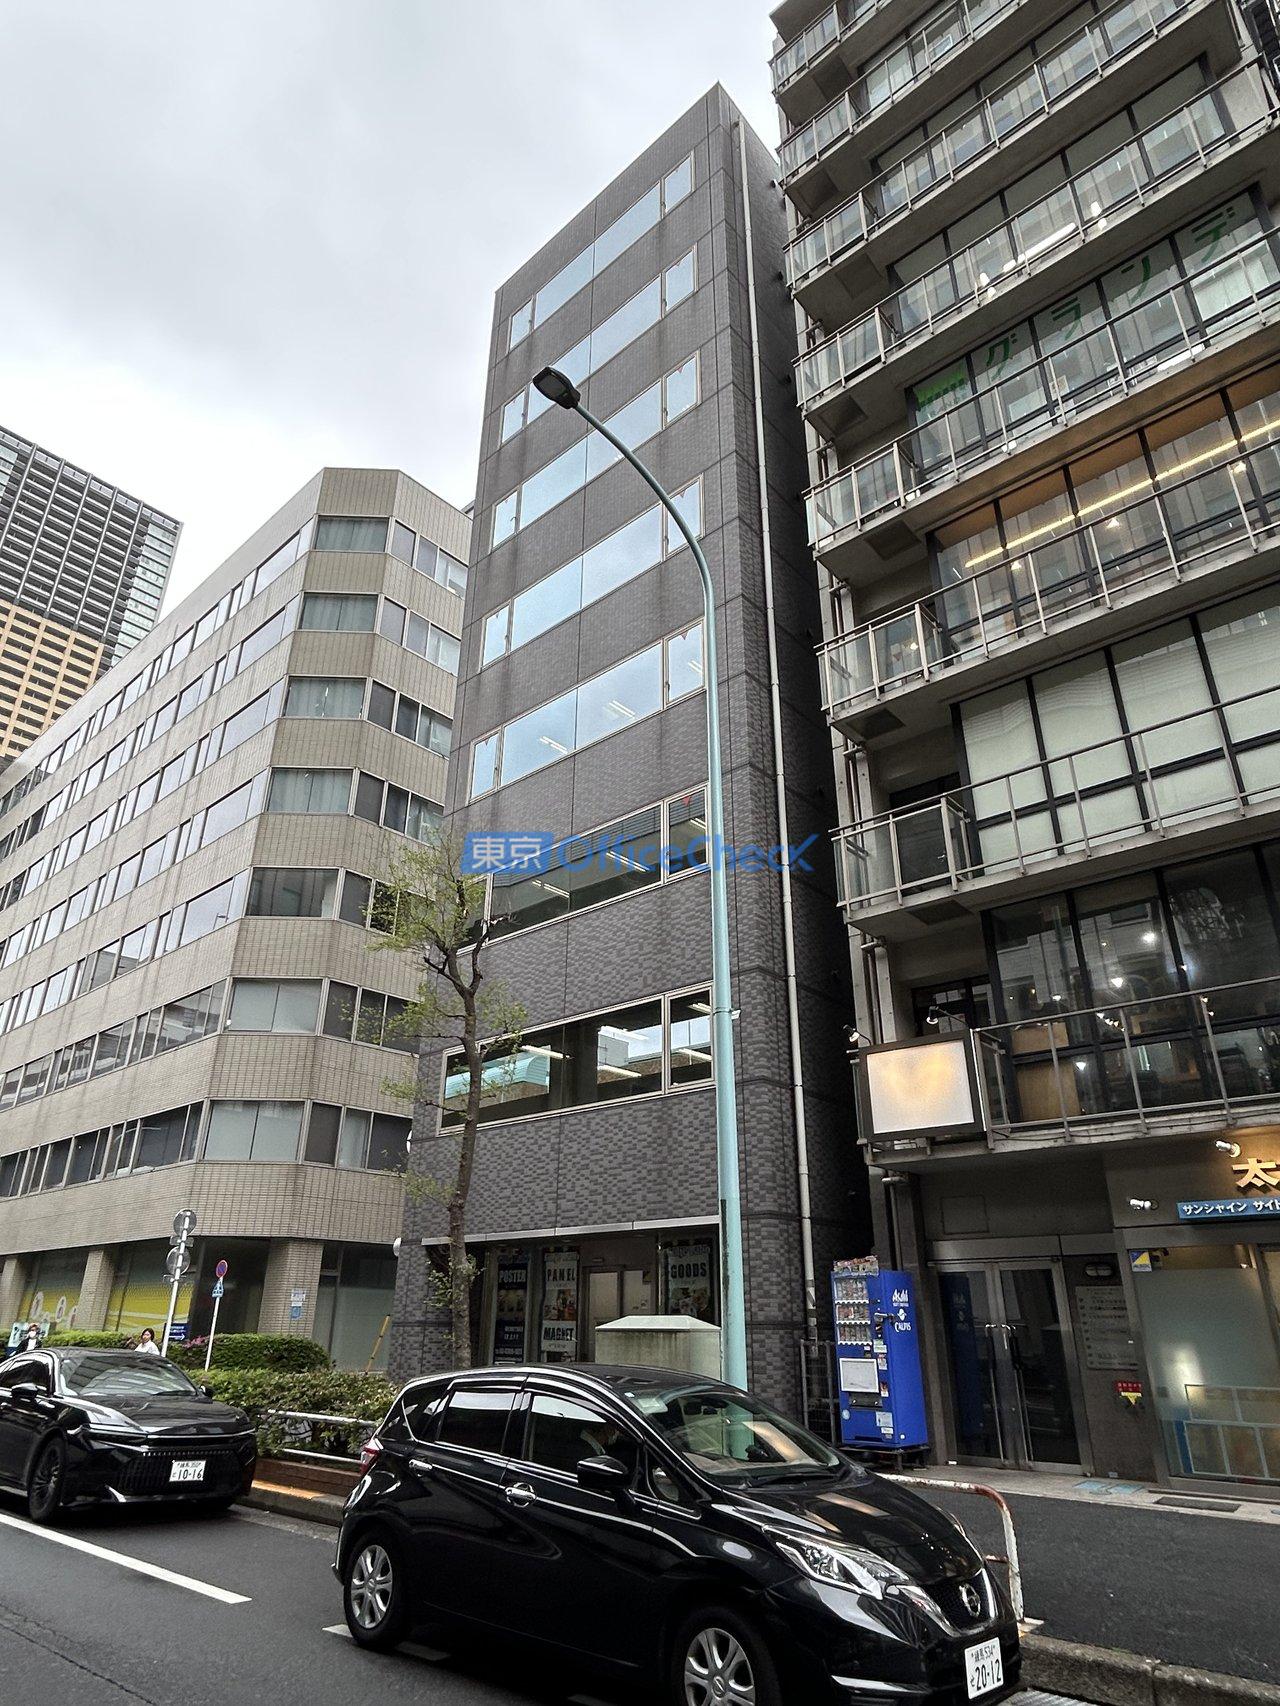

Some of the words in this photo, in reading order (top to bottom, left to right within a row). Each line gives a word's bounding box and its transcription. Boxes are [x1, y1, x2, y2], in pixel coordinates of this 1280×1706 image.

[1231, 1157, 1280, 1188] 太
[1182, 1201, 1247, 1215] サンシャイン
[499, 1269, 526, 1283] POSTER
[547, 1268, 575, 1282] PANEL
[670, 1262, 707, 1279] GOODS
[543, 1327, 574, 1341] MAGNET
[178, 1469, 203, 1480] 10-16
[975, 1658, 1002, 1691] 20-12
